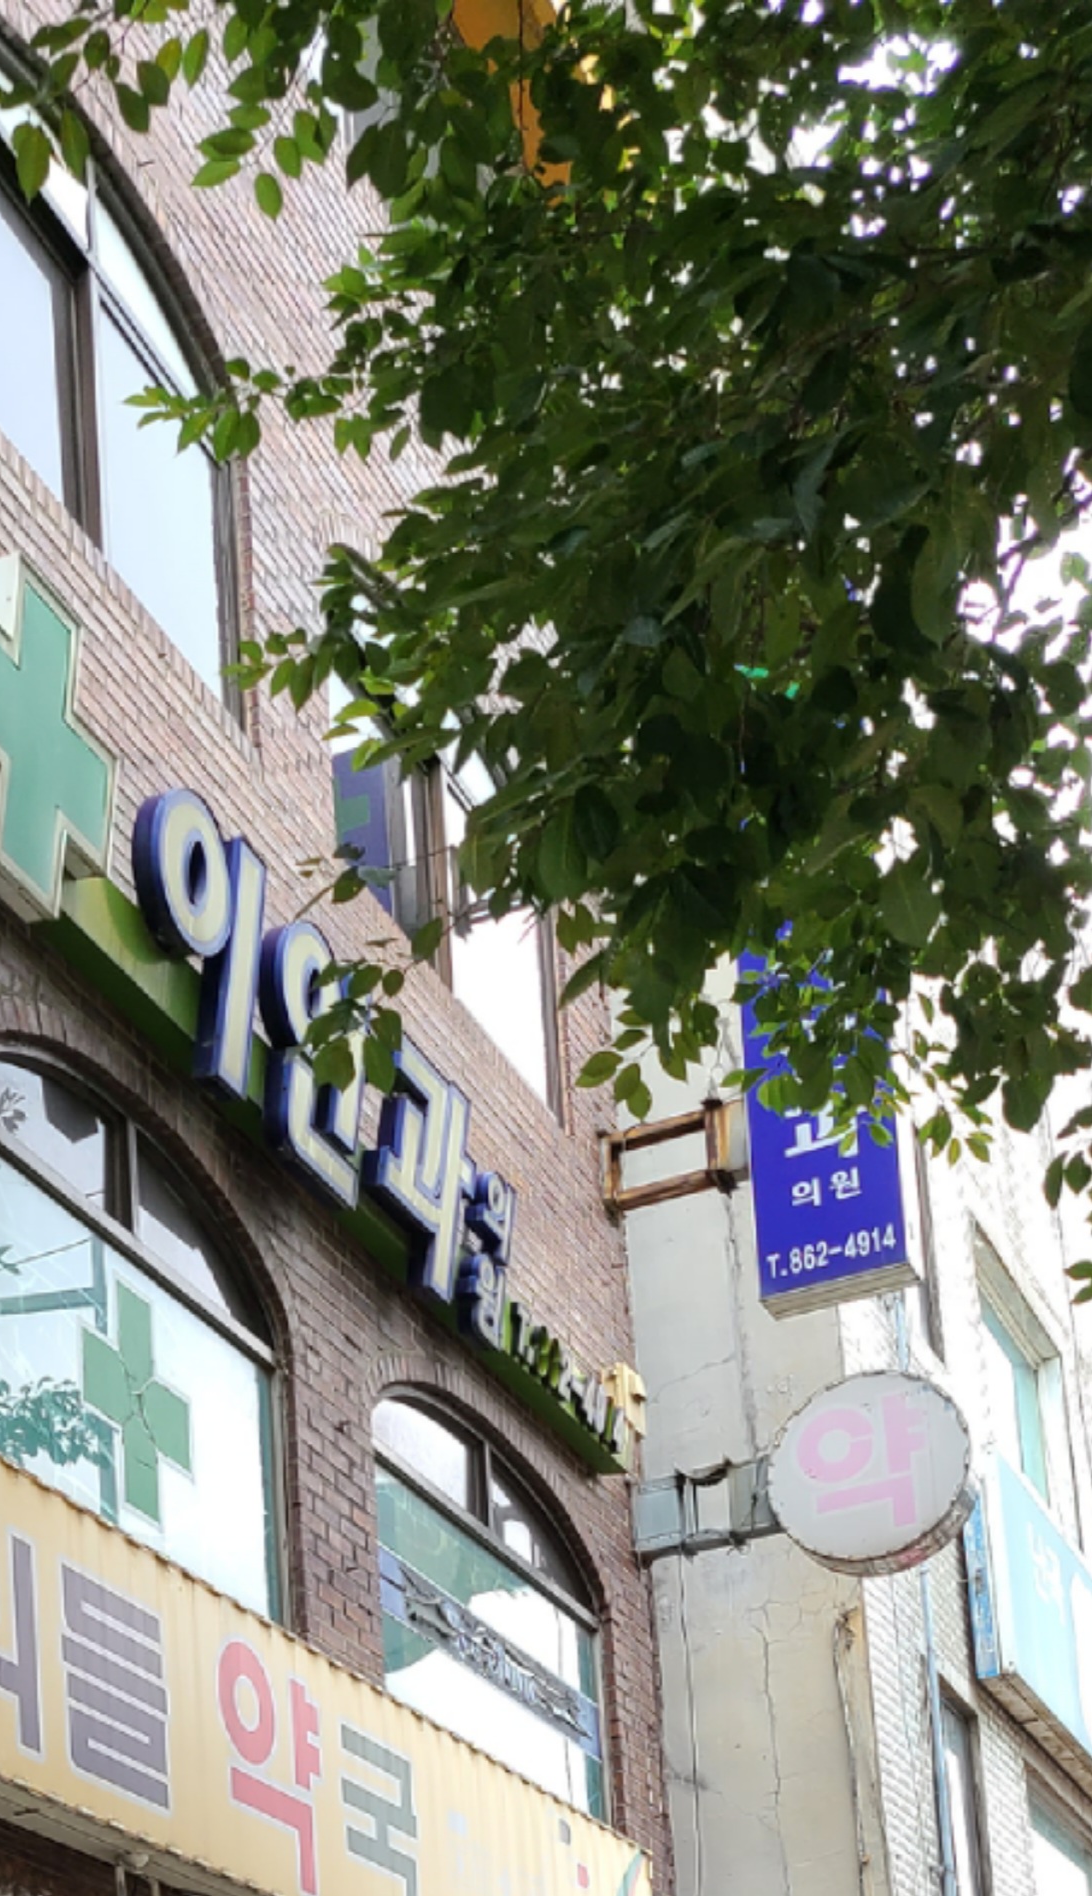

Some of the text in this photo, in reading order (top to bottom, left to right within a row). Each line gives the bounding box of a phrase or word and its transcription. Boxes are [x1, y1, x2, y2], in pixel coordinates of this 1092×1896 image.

[791, 1166, 863, 1207] 의원
[766, 1222, 897, 1280] T.862-4914
[795, 1391, 928, 1528] 약
